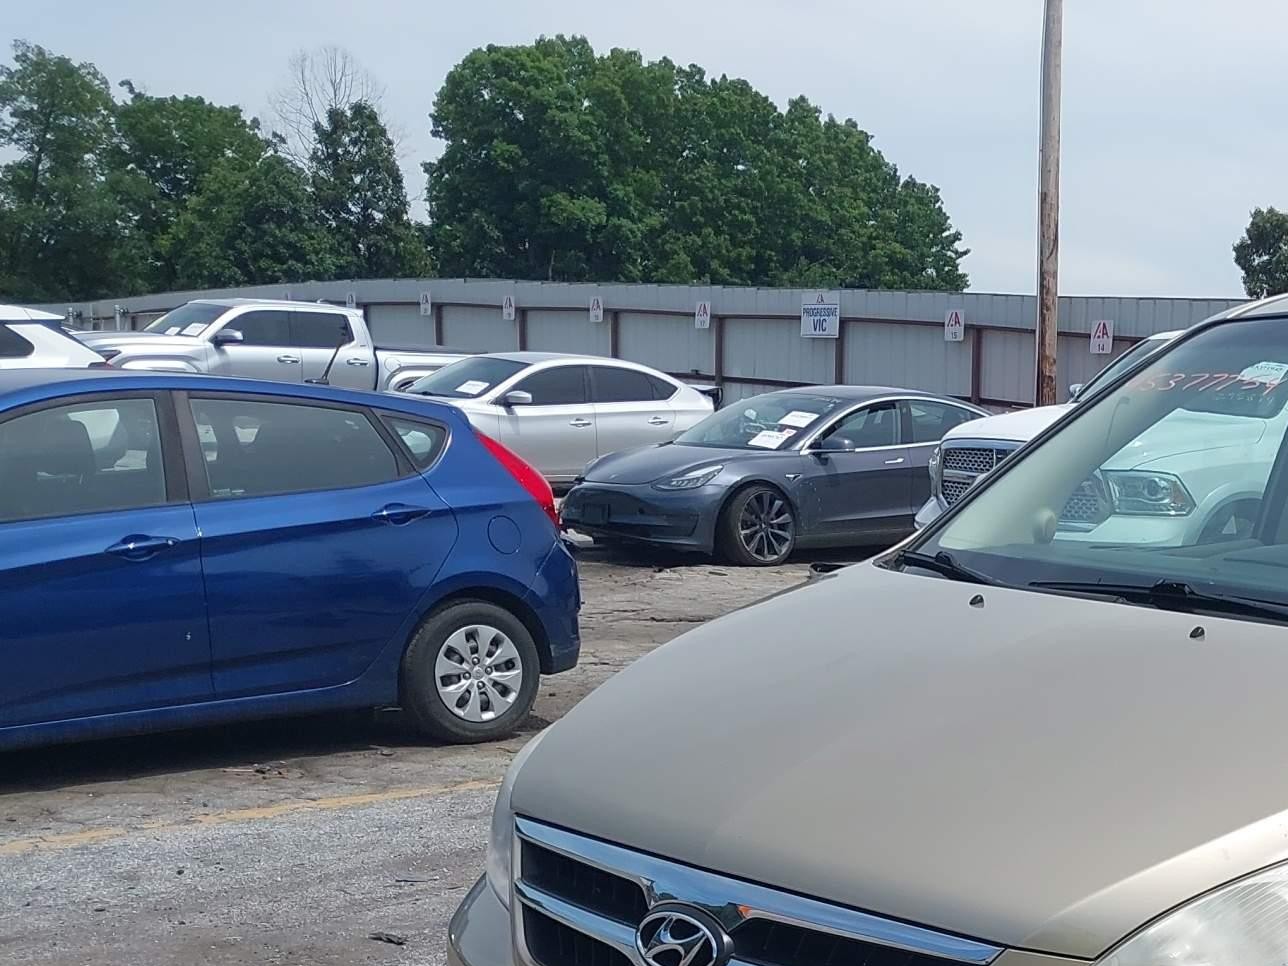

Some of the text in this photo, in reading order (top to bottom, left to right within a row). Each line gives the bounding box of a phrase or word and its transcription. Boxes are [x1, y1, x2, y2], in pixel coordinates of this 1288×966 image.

[802, 307, 839, 318] PROGRESSIVE
[812, 318, 828, 333] VIC
[1098, 343, 1105, 352] 14
